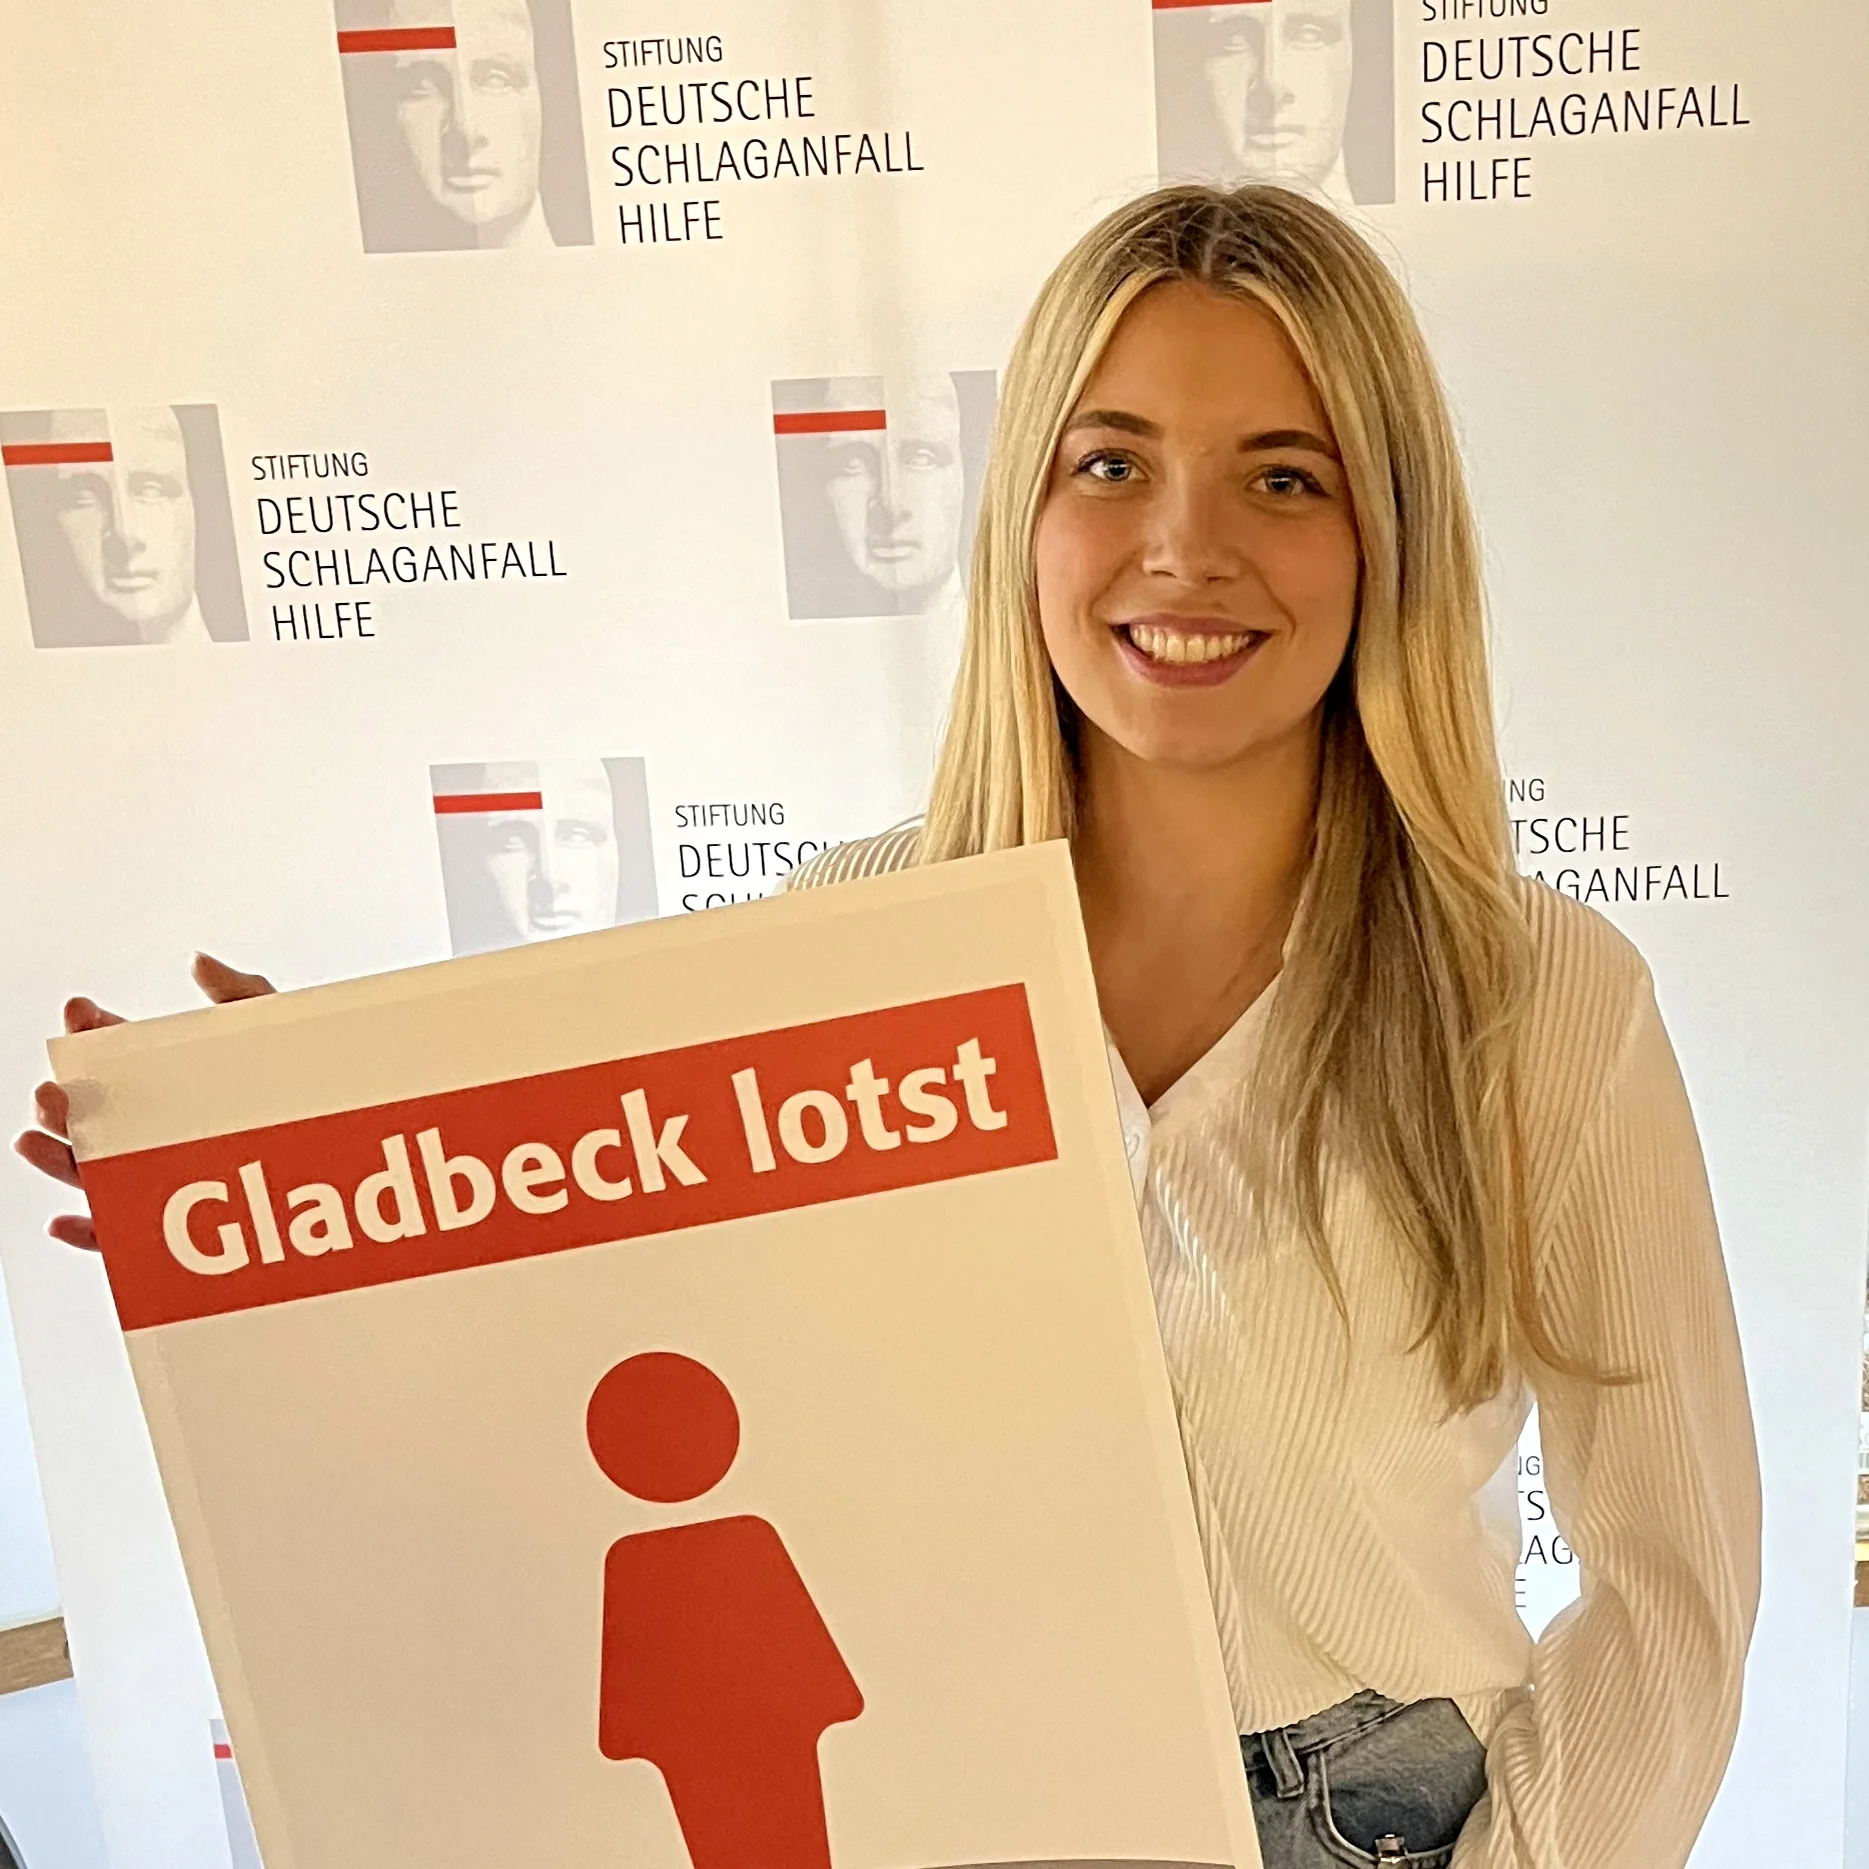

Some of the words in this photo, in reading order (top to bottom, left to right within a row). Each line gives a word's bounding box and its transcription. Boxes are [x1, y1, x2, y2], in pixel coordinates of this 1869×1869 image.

[603, 35, 723, 69] STIFTUNG
[1422, 28, 1641, 83] DEUTSCHE
[607, 76, 816, 128] DEUTSCHE
[1421, 83, 1751, 144] SCHLAGANFALL
[611, 130, 925, 187] SCHLAGANFALL
[1423, 156, 1532, 203] HILFE
[618, 199, 724, 245] HILFE
[251, 451, 369, 481] STIFTUNG
[256, 490, 462, 535] DEUTSCHE
[262, 540, 568, 589] SCHLAGANFALL
[272, 601, 376, 642] HILFE
[1502, 778, 1546, 802] NG
[675, 802, 785, 828] STIFTUNG
[161, 1088, 708, 1277] Gladbeck
[731, 1037, 1009, 1174] lotst
